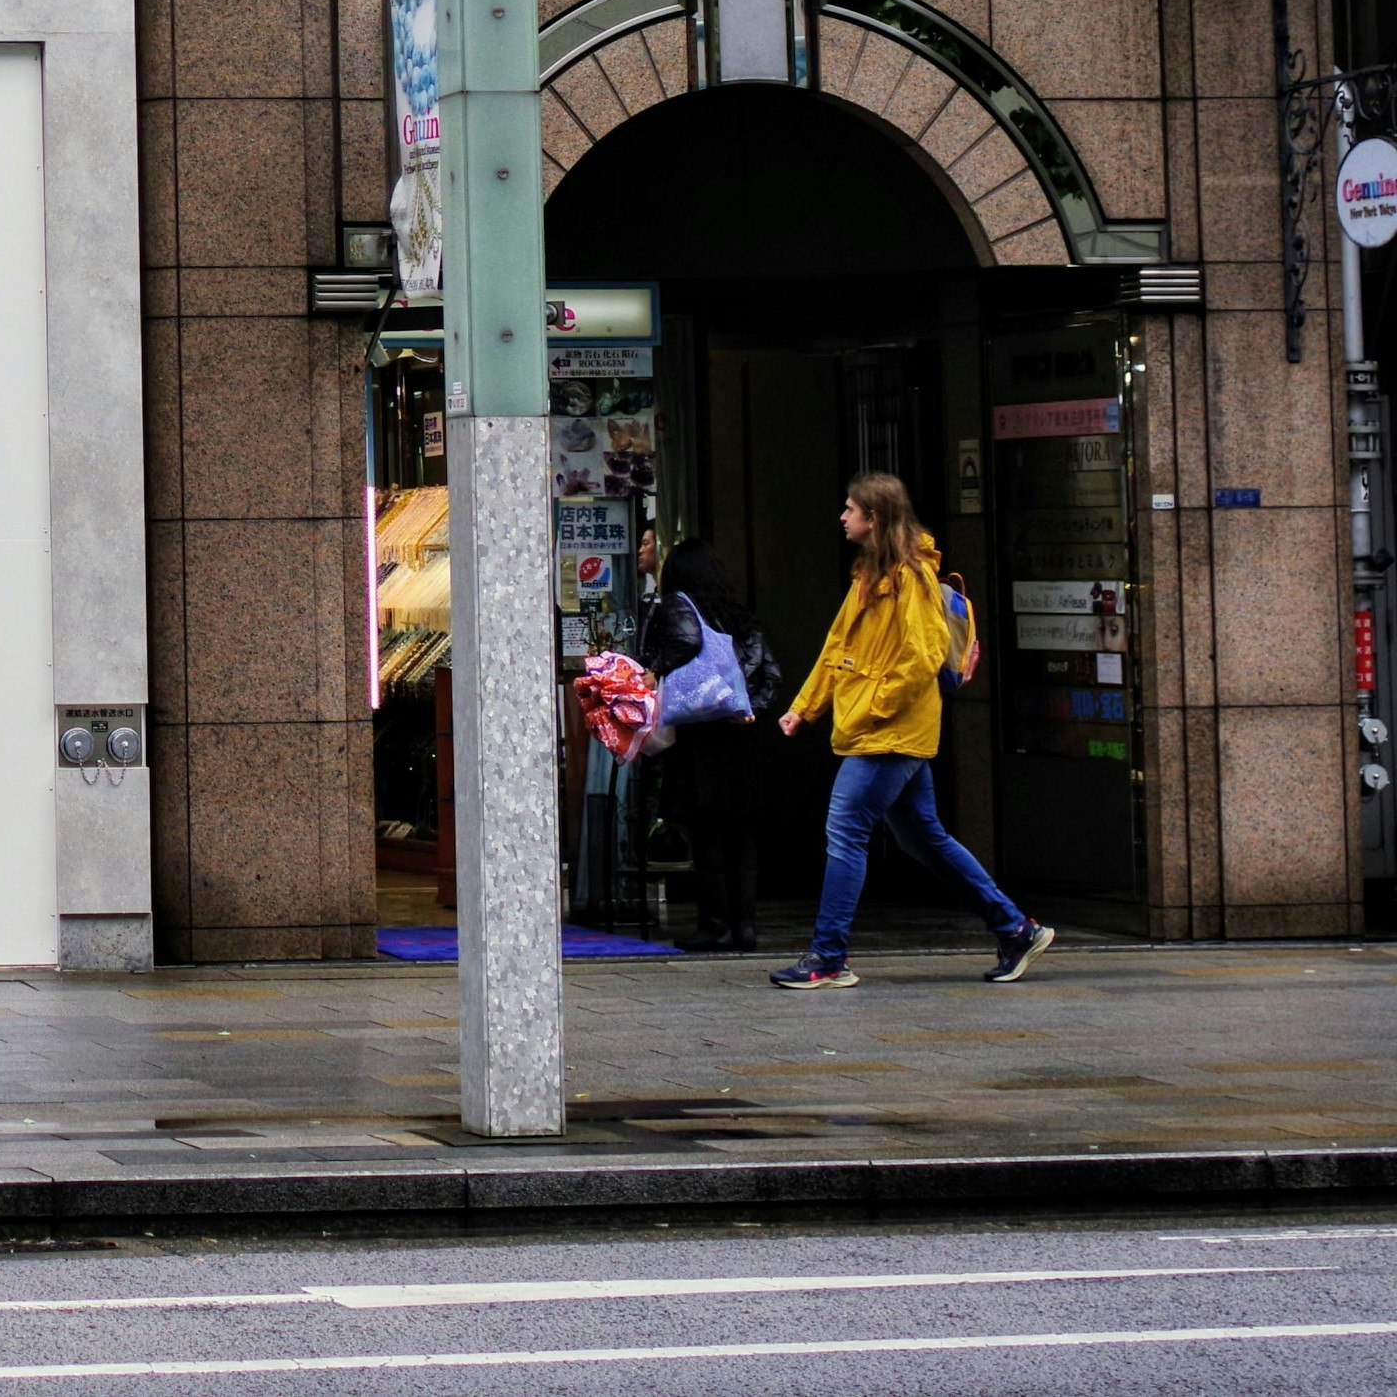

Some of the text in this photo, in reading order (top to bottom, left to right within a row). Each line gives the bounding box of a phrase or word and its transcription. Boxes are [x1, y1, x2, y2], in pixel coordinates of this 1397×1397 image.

[1342, 172, 1397, 202] Genuin
[560, 505, 608, 523] 店内有
[561, 523, 626, 541] 日本真珠
